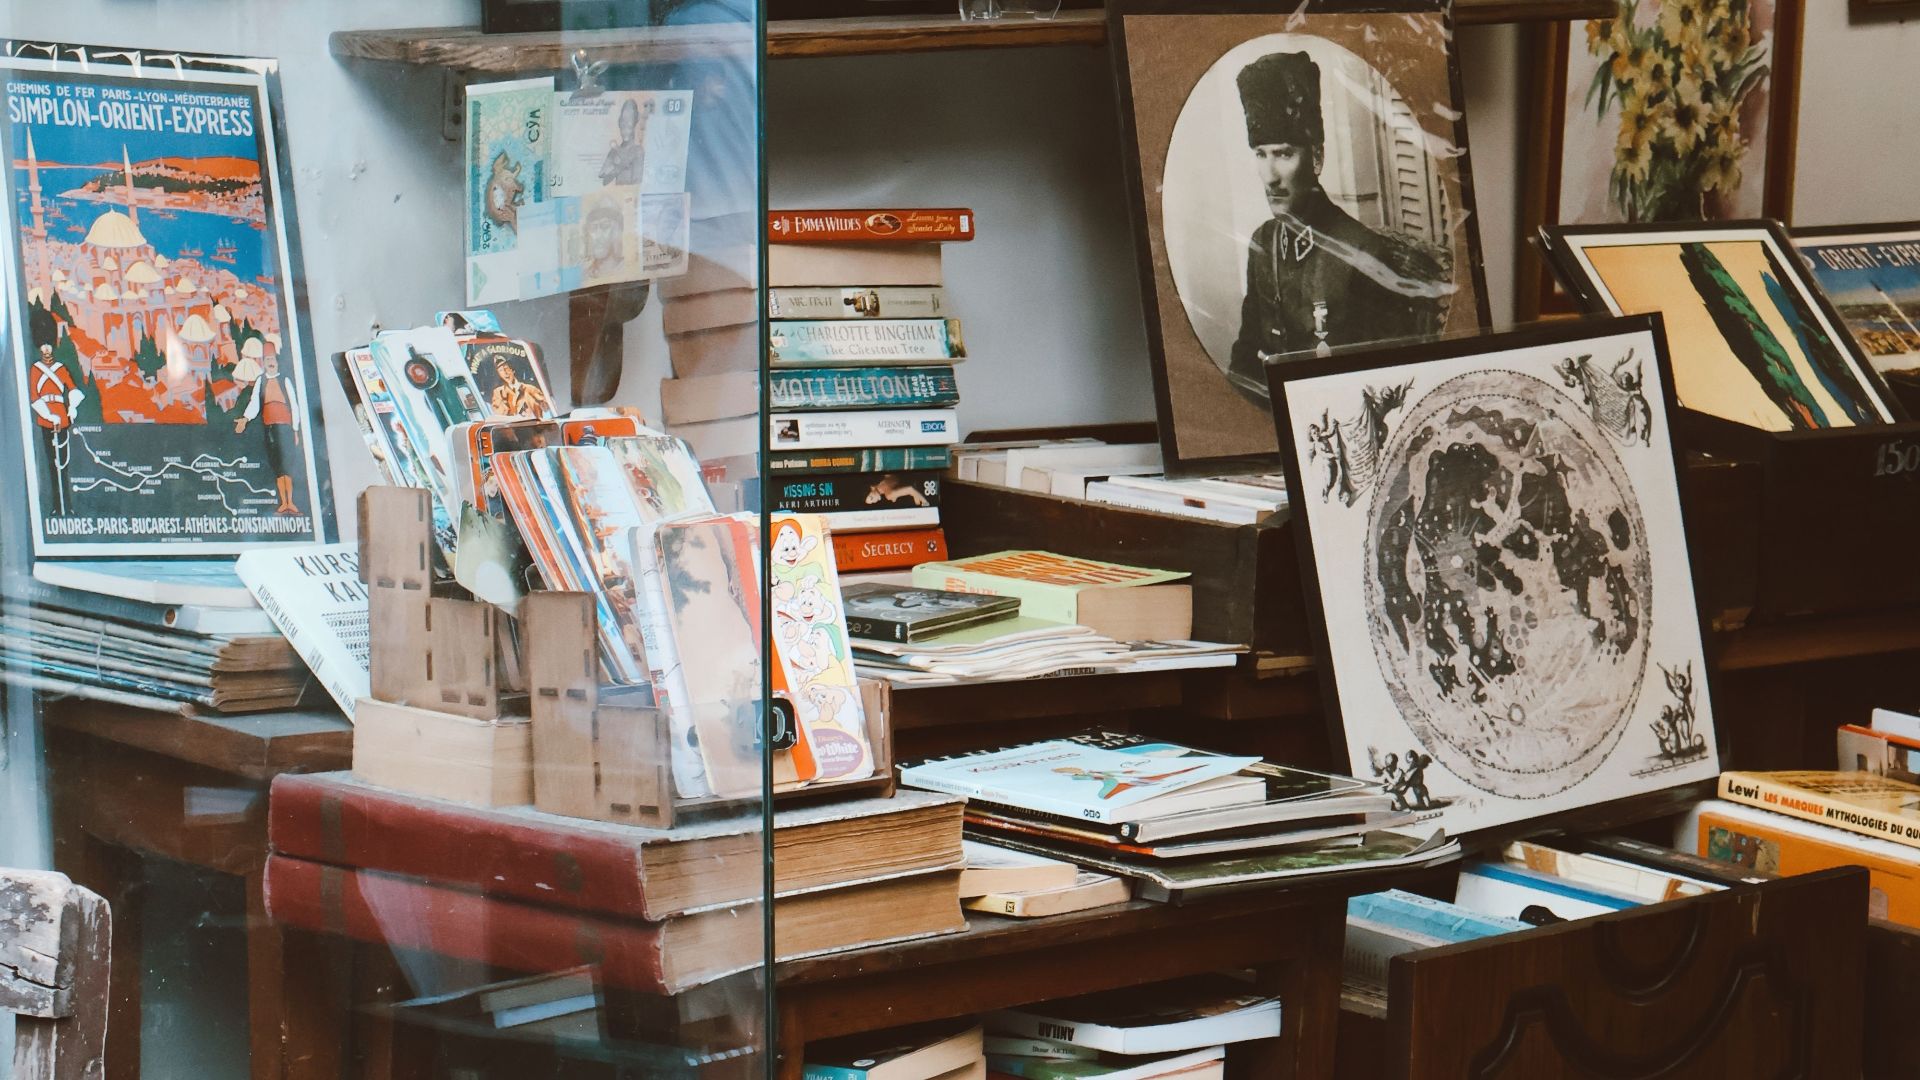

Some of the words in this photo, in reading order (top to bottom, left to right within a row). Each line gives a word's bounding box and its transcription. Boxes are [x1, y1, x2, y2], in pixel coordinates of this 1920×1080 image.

[7, 82, 50, 95] CHEMINS
[57, 86, 69, 96] DE
[75, 87, 95, 98] FER
[667, 101, 680, 112] 50
[9, 96, 253, 136] SIMPLON-ORIENT-EXPRESS
[795, 216, 825, 233] EMMA
[825, 217, 861, 232] WILDES
[934, 222, 955, 234] Lady
[797, 326, 870, 342] CHARLOTTE
[874, 325, 936, 341] BINGHAM
[487, 345, 526, 358] GLORIOUS
[825, 345, 844, 355] The
[850, 344, 901, 355] Chestnut
[903, 344, 925, 354] Tree
[770, 377, 826, 401] MATT
[834, 376, 912, 401] HILTON
[911, 376, 921, 397] DEAD
[927, 376, 937, 397] DUST
[784, 483, 816, 498] KISSING
[820, 482, 833, 497] SIN
[779, 500, 800, 509] KERI
[804, 499, 841, 508] ARTHUR
[861, 542, 914, 558] SECRECY
[1728, 780, 1760, 800] Lewi
[1764, 792, 1778, 804] LES
[1781, 794, 1824, 816] MARQUES
[1826, 807, 1888, 832] MYTHOLOGIES
[1890, 820, 1904, 835] DU
[1905, 824, 1920, 841] QU
